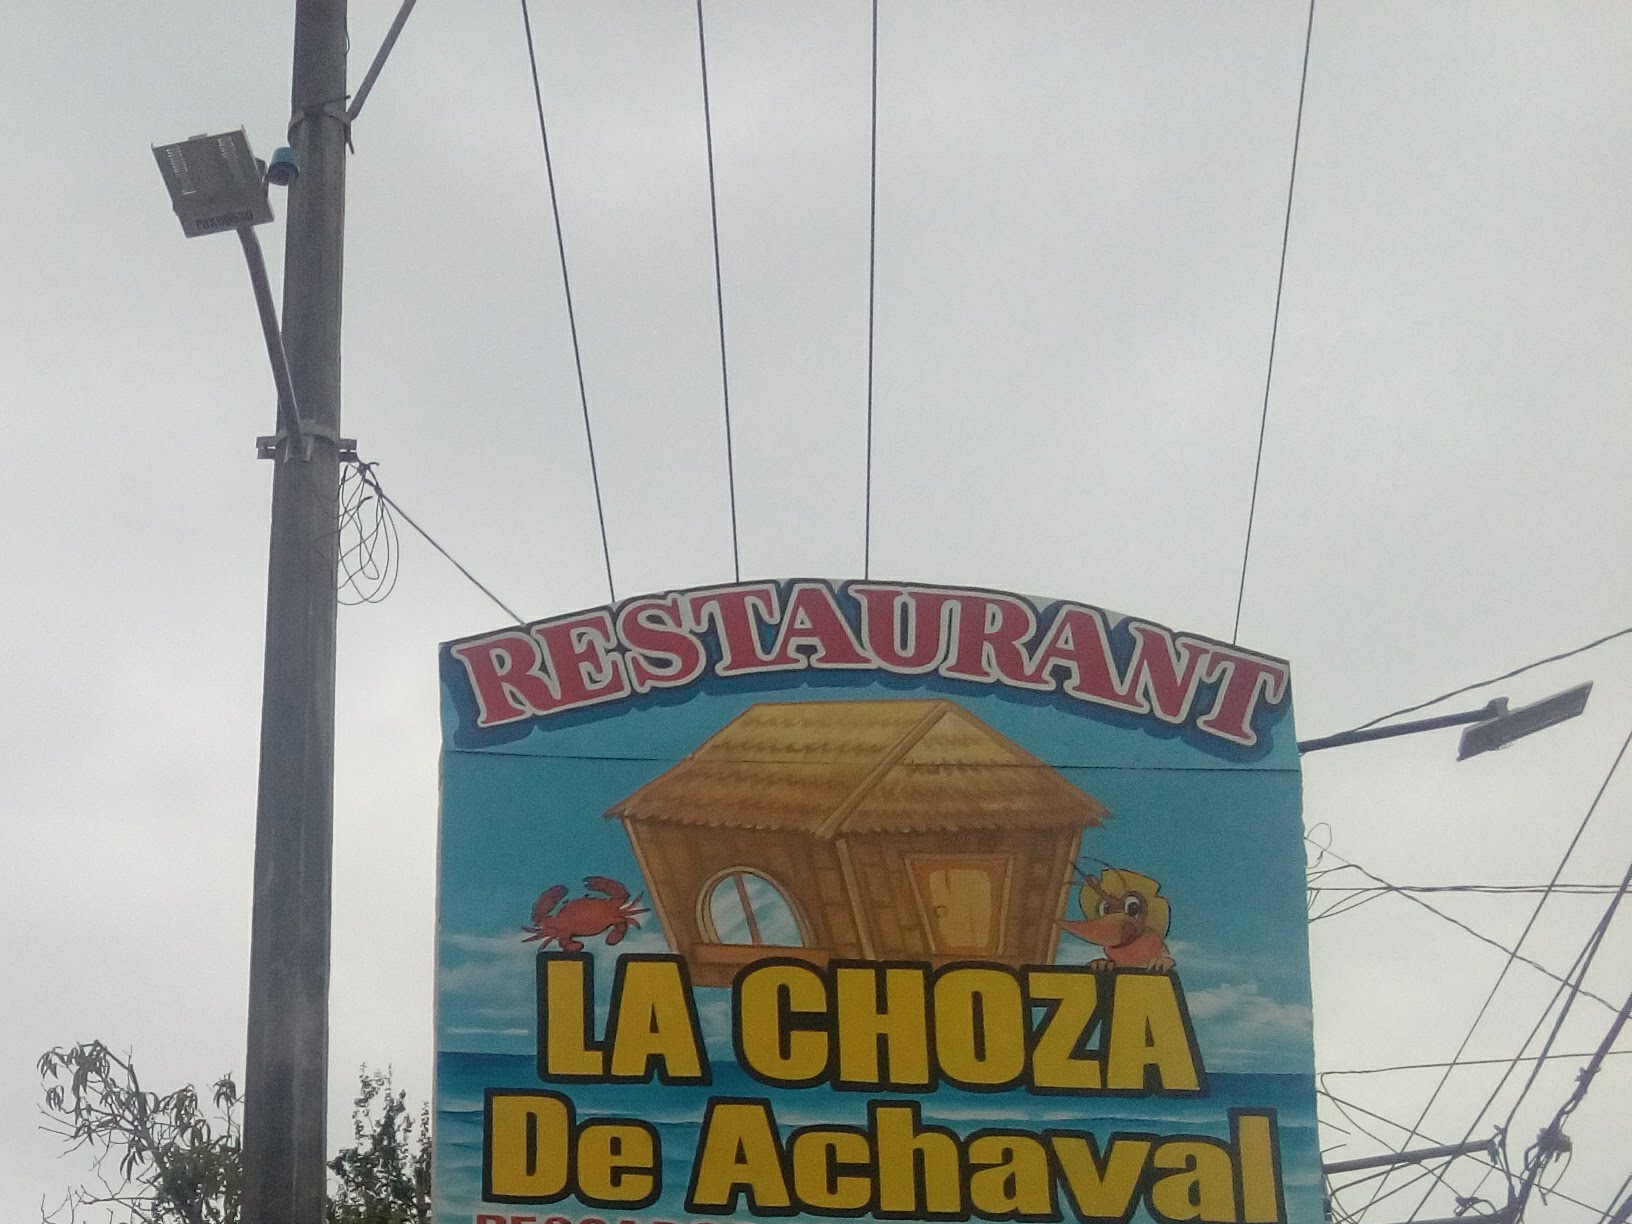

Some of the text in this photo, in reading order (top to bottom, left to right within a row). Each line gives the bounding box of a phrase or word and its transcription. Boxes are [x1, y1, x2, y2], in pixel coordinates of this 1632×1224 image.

[451, 579, 1288, 747] RESTAURANT
[536, 951, 1211, 1097] LA CHOZA
[483, 1088, 663, 1210] De
